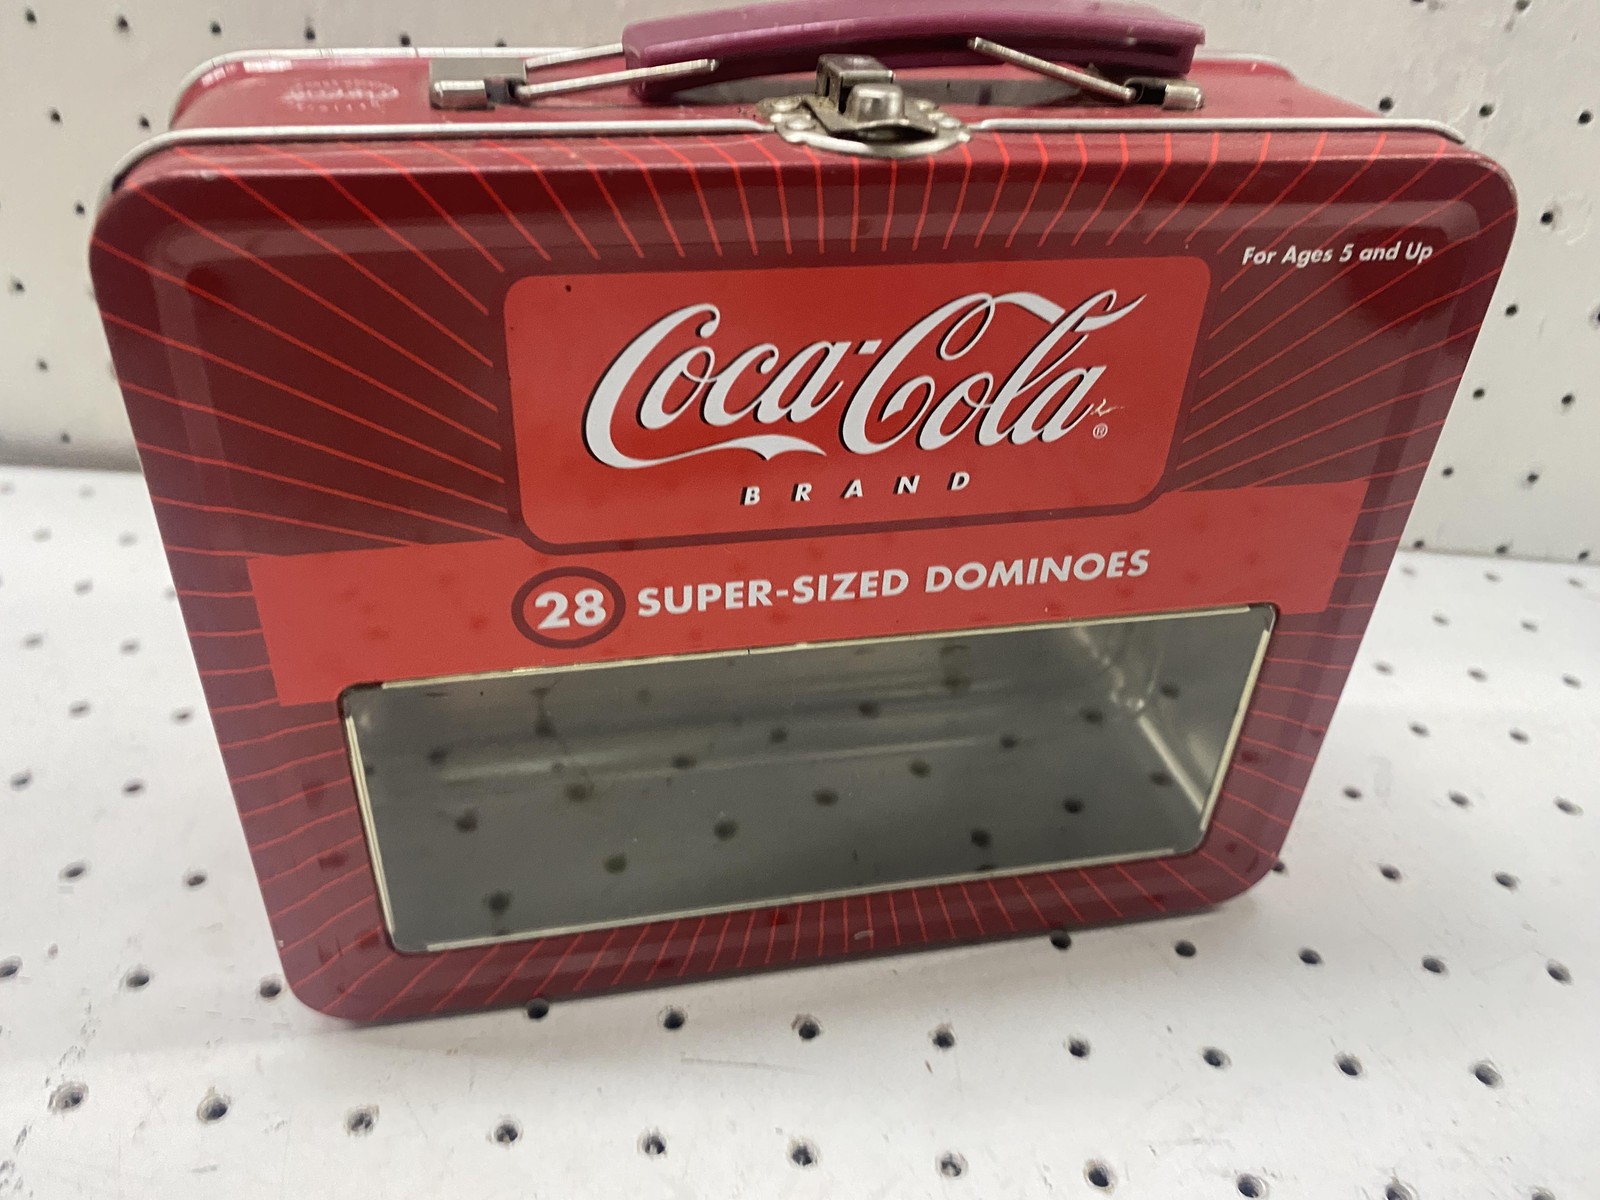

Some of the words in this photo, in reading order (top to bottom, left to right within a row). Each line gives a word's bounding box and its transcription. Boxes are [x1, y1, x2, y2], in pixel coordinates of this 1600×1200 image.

[1241, 246, 1277, 265] For
[1281, 245, 1333, 268] Ages
[1338, 243, 1354, 262] 5
[1358, 241, 1402, 261] and
[1405, 241, 1434, 265] Up
[583, 290, 1147, 469] Coca-Cola
[742, 471, 972, 506] BRAND
[534, 590, 607, 629] 28
[637, 568, 909, 618] SUPER-SIZED
[925, 549, 1151, 593] DOMINOES
